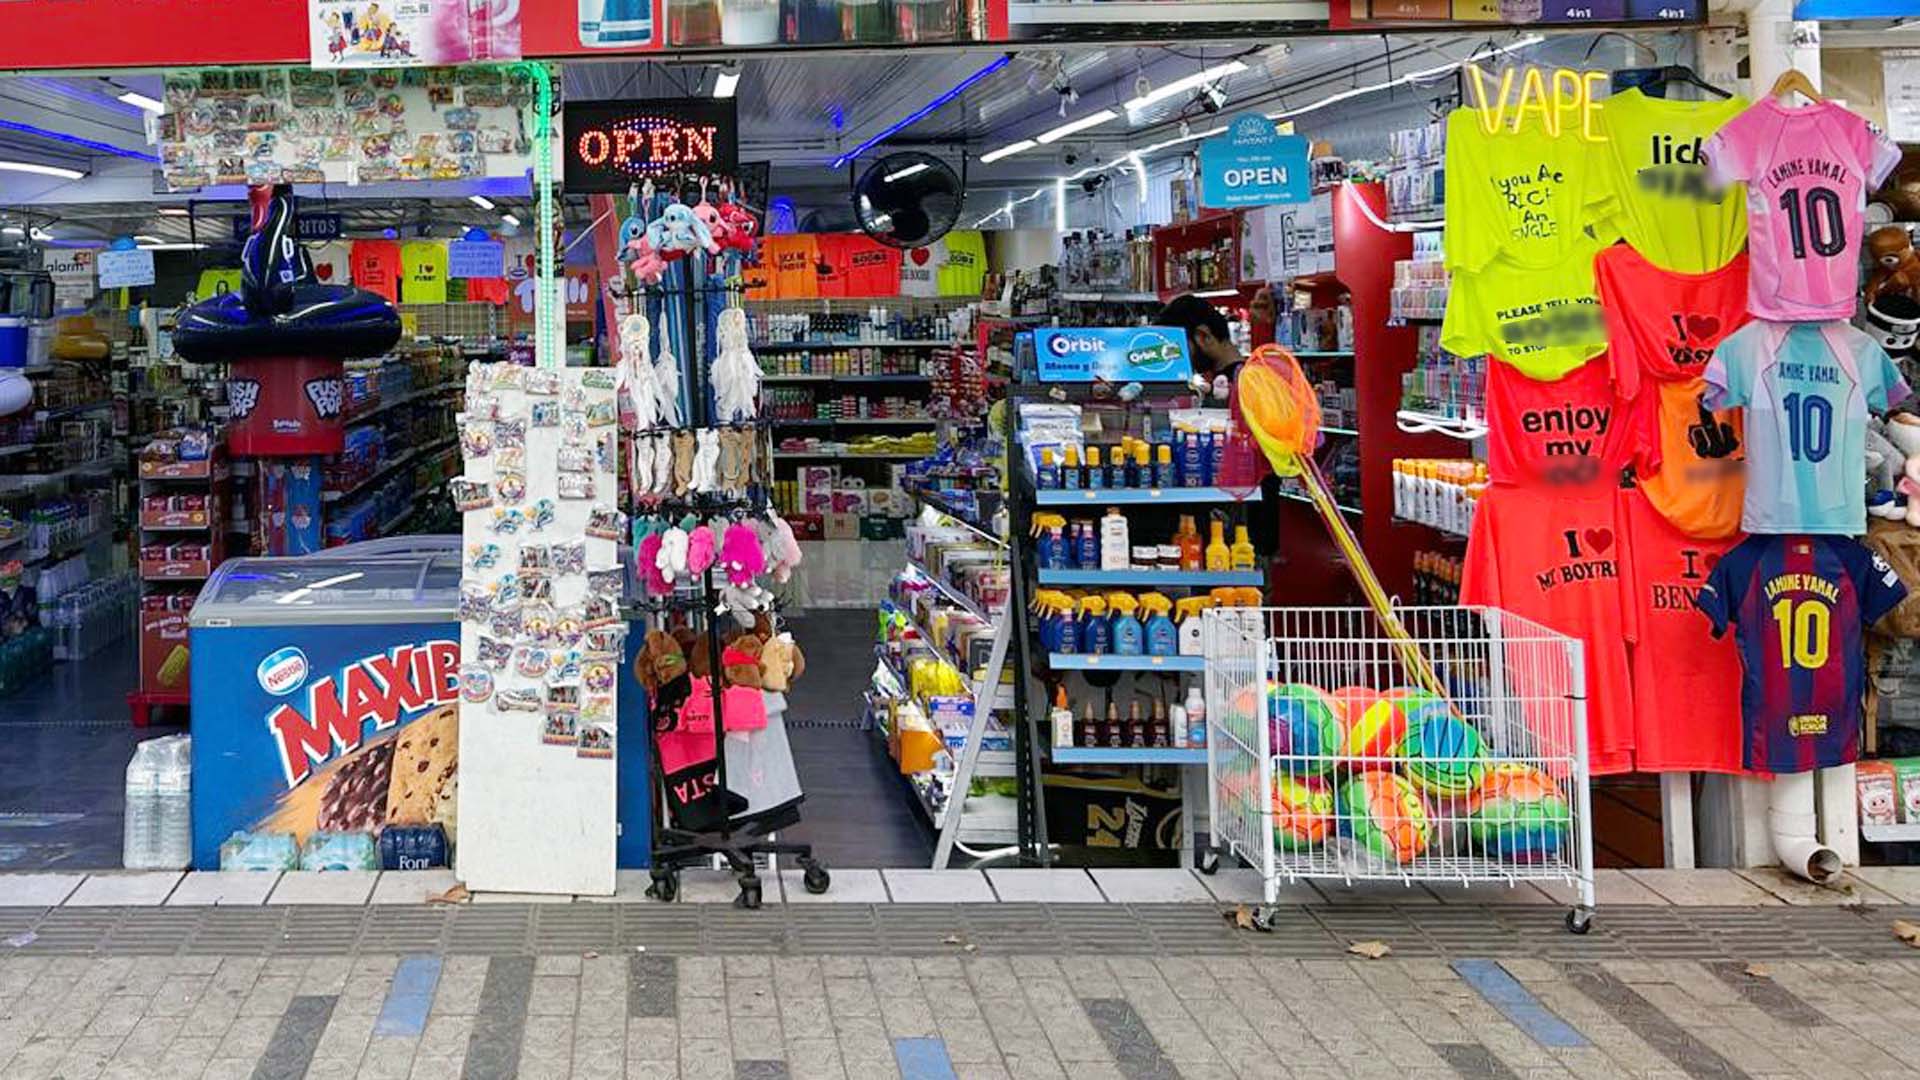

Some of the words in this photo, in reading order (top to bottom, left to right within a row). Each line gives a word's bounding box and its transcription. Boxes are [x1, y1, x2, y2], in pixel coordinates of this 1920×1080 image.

[1566, 8, 1592, 18] 4in1
[1658, 8, 1685, 18] 4in1
[1467, 64, 1609, 142] VAPE
[578, 126, 717, 165] OPEN
[1652, 135, 1708, 166] lick
[1223, 166, 1288, 187] OPEN
[1537, 163, 1564, 184] Ae
[1767, 158, 1805, 189] LAMINE
[1807, 158, 1846, 184] YAMAL
[1779, 186, 1847, 259] 10
[1496, 303, 1542, 321] PLEASE
[1672, 314, 1687, 341] I
[1051, 336, 1106, 355] Orbit
[1129, 350, 1157, 363] Orbit
[1524, 344, 1547, 353] STO
[1779, 361, 1804, 381] AMINE
[1522, 402, 1611, 436] enjoy
[1783, 391, 1833, 463] 10
[1564, 530, 1582, 558] I
[1681, 550, 1701, 579] I
[1764, 574, 1800, 601] LAMINE
[1803, 574, 1840, 604] YAMAL
[1772, 599, 1830, 669] 10
